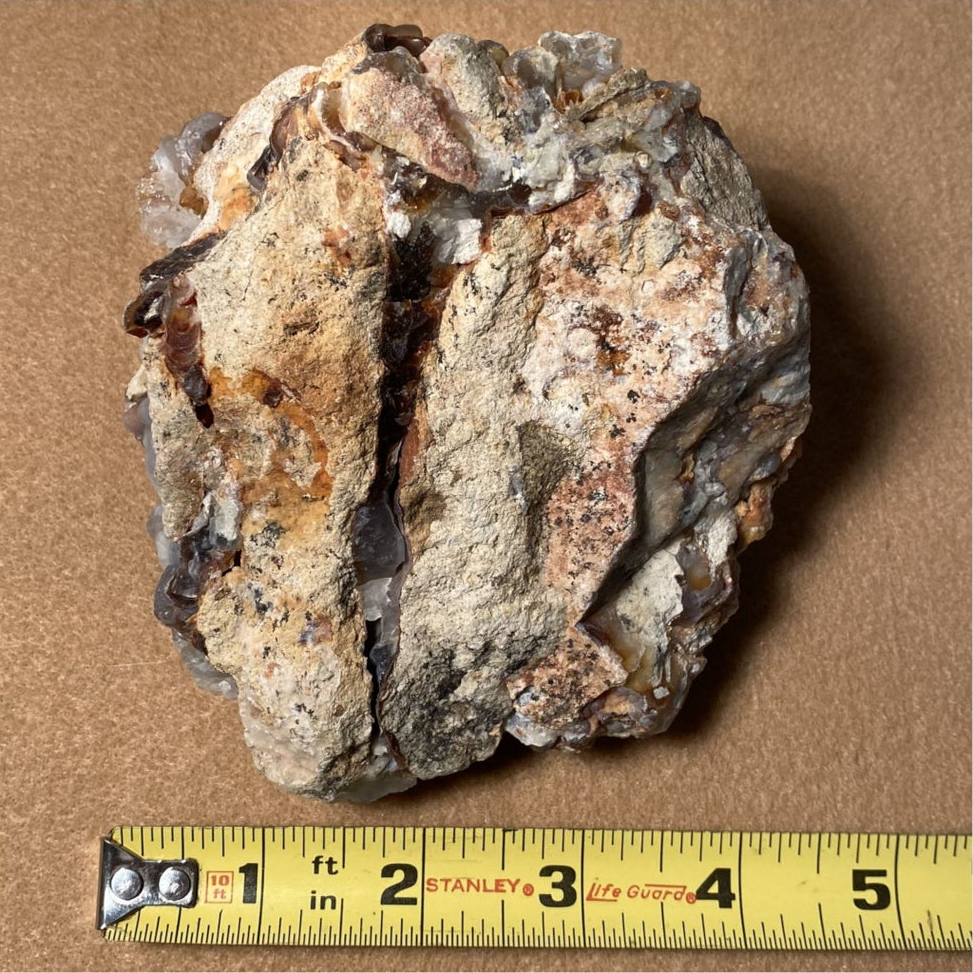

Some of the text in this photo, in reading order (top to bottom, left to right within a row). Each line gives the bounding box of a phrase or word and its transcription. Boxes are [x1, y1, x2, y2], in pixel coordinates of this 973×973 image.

[210, 875, 229, 886] 10
[239, 863, 258, 903] 1
[312, 856, 338, 874] ft
[381, 864, 418, 905] 2
[213, 889, 227, 899] ft
[311, 891, 336, 909] in
[538, 866, 577, 907] 3
[696, 868, 735, 908] 4
[852, 869, 891, 910] 5
